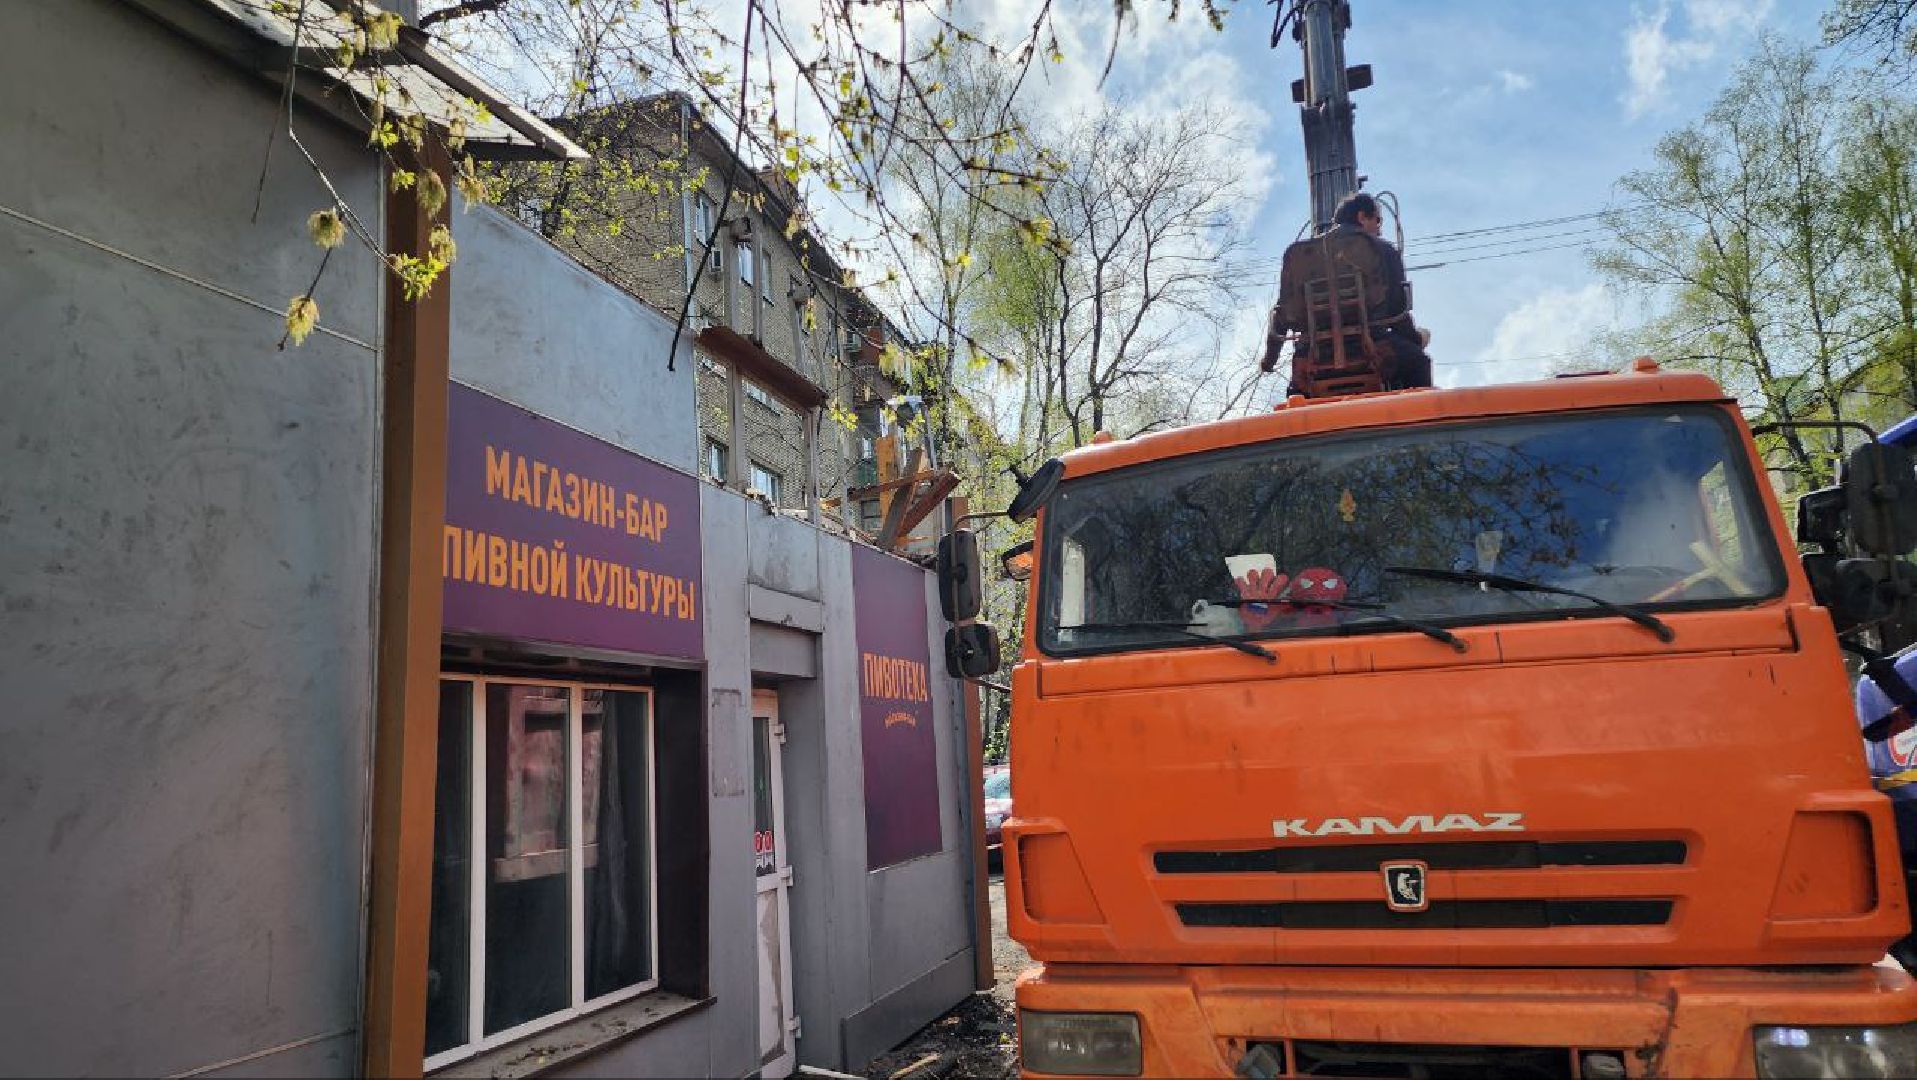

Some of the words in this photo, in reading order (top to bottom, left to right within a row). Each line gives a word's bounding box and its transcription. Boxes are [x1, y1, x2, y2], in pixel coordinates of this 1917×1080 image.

[485, 445, 668, 543] МАГАЗИН-БАР
[442, 524, 568, 598] ПИВНОЙ
[575, 554, 695, 621] КУЛЬТУРЫ
[863, 652, 928, 702] ПИВОТЕКА
[1272, 813, 1526, 838] KAMAZ
